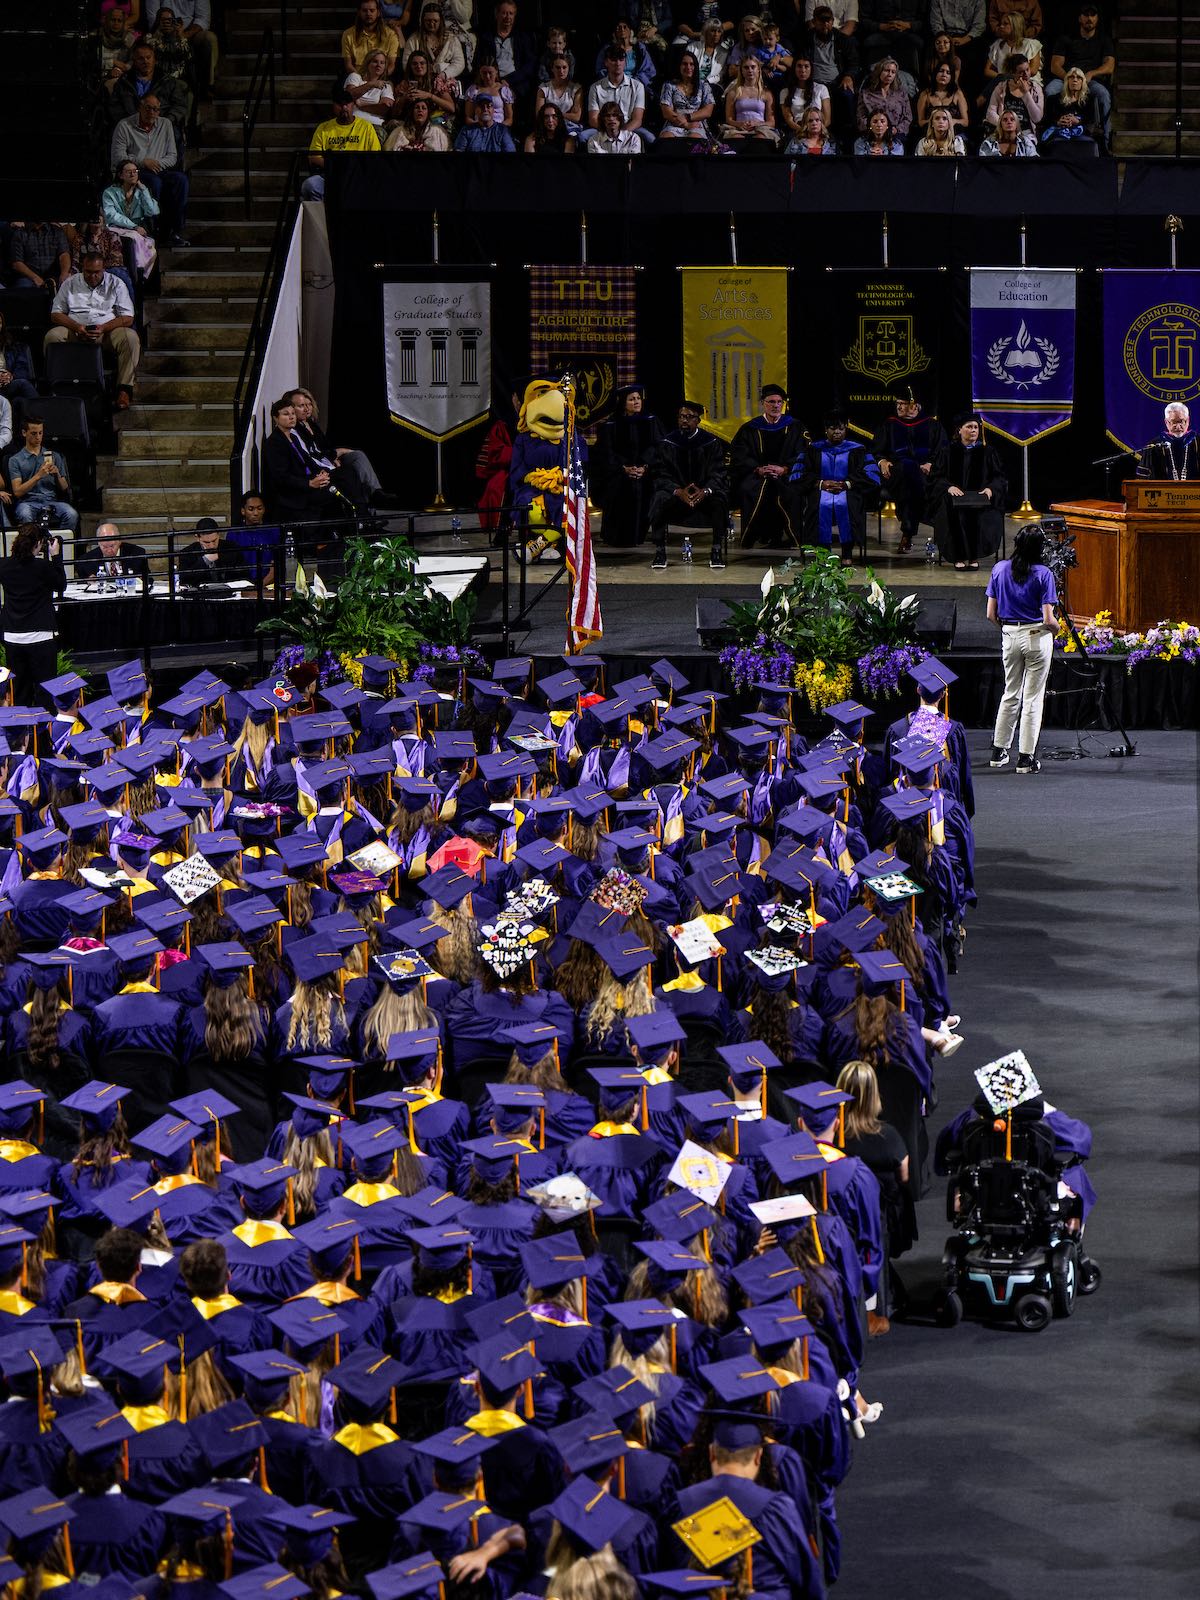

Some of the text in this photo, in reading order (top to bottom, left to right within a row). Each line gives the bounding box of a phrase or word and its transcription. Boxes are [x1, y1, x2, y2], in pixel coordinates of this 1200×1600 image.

[718, 278, 742, 286] College
[1004, 280, 1041, 289] College of
[554, 280, 612, 300] TTU
[414, 294, 464, 306] College of
[713, 288, 747, 303] Arts
[999, 291, 1048, 301] Education
[393, 309, 482, 320] Graduate Studies
[699, 304, 773, 320] Sciences
[538, 316, 629, 326] AGRICULTURE
[537, 333, 628, 342] HUMAN ECOLOGY
[1126, 338, 1152, 392] TENNESSEE
[1160, 391, 1186, 400] 1915
